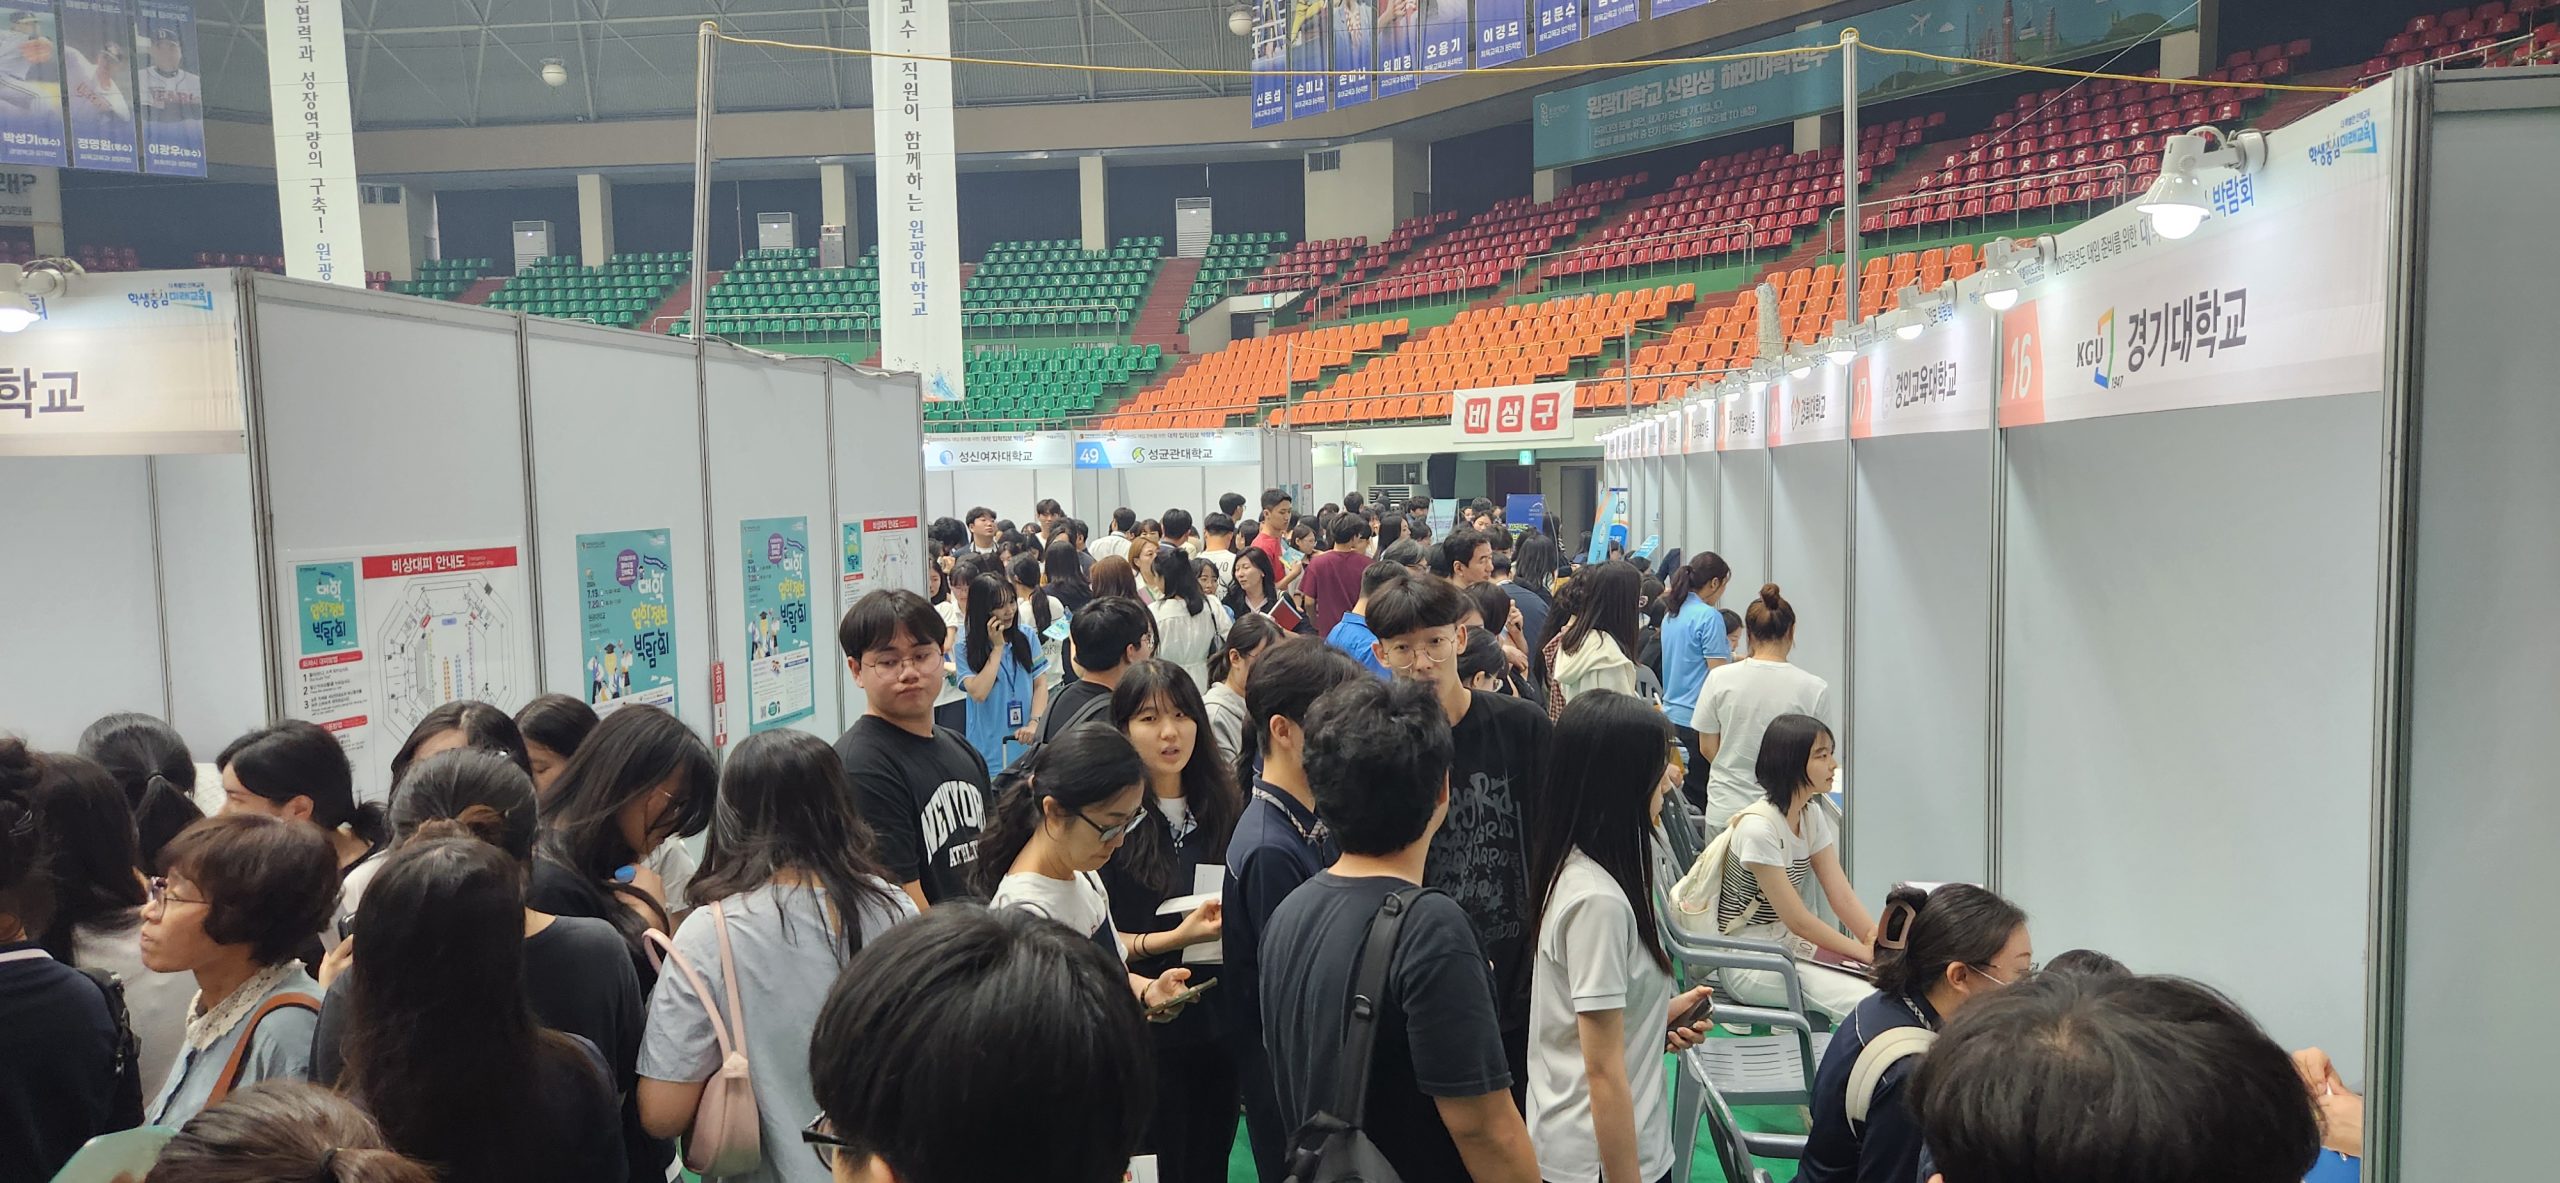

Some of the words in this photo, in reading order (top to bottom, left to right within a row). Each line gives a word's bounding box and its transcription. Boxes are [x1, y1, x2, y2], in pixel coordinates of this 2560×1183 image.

[1587, 82, 1663, 120] 원광대학교
[1665, 68, 1715, 101] 신입생
[301, 71, 323, 168] 성장역량의
[905, 130, 924, 213] 함께하는
[309, 177, 327, 233] 구축!
[2056, 246, 2087, 275] 2025학년도
[2088, 239, 2100, 263] 대입
[2101, 230, 2122, 259] 준비를
[2122, 224, 2138, 248] 위한
[2212, 173, 2253, 217] 박람회
[316, 242, 334, 281] 원광
[908, 219, 928, 317] 원광대학교
[2076, 337, 2103, 367] KGU
[2128, 288, 2247, 372] 경기대학교
[1895, 360, 1957, 409] 경인교육대학교
[2011, 332, 2032, 400] 16
[1468, 399, 1555, 429] 비상구
[1856, 377, 1868, 421] 17
[959, 450, 1033, 463] 성신여자대학교
[1079, 447, 1099, 463] 49
[1148, 448, 1213, 460] 성균관대학교
[391, 558, 433, 574] 비상대피
[436, 554, 466, 570] 안내도
[634, 628, 670, 668] 박람회
